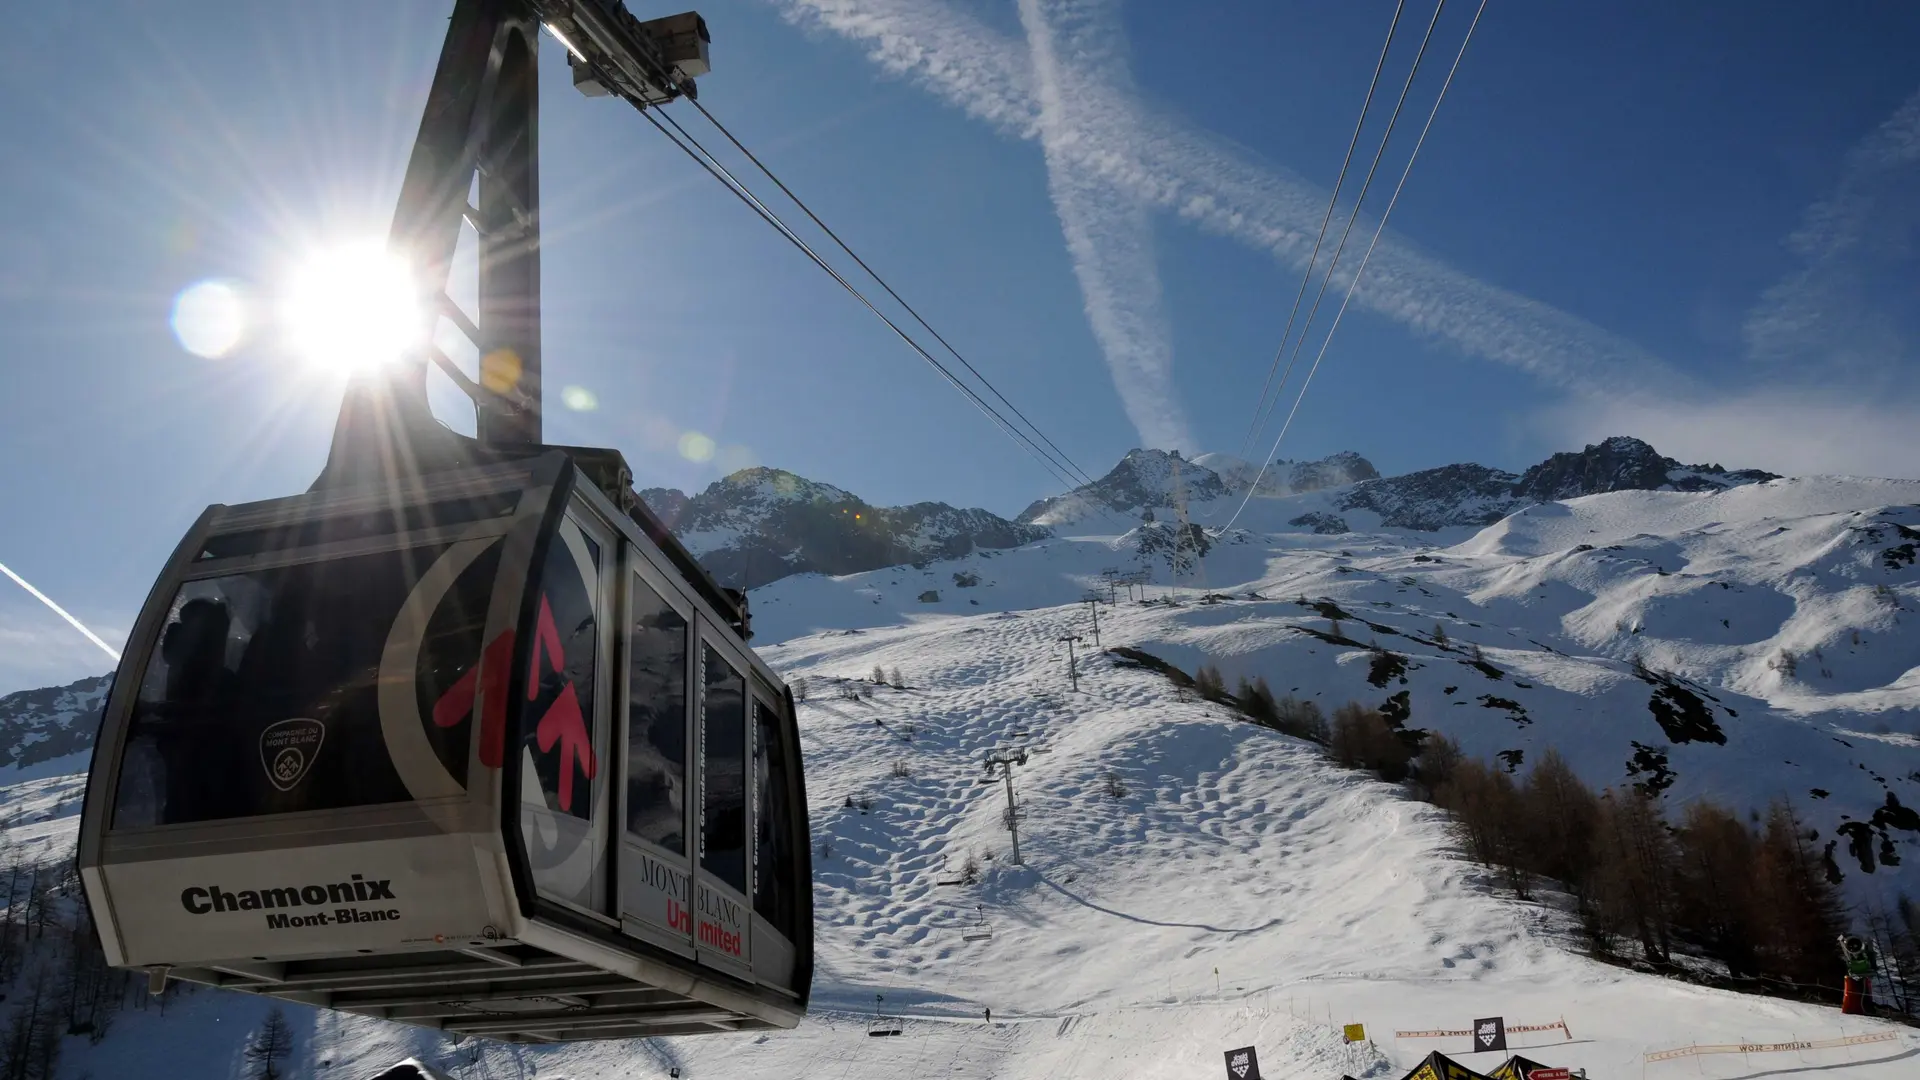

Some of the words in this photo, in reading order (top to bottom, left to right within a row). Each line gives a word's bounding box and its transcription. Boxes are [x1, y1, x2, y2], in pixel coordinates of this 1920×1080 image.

[266, 738, 288, 747] MONT
[290, 735, 317, 744] BLANC
[181, 874, 397, 915] Chamonix
[641, 855, 690, 902] MONT
[697, 884, 741, 929] BLANC
[266, 908, 401, 930] Mont-Blanc
